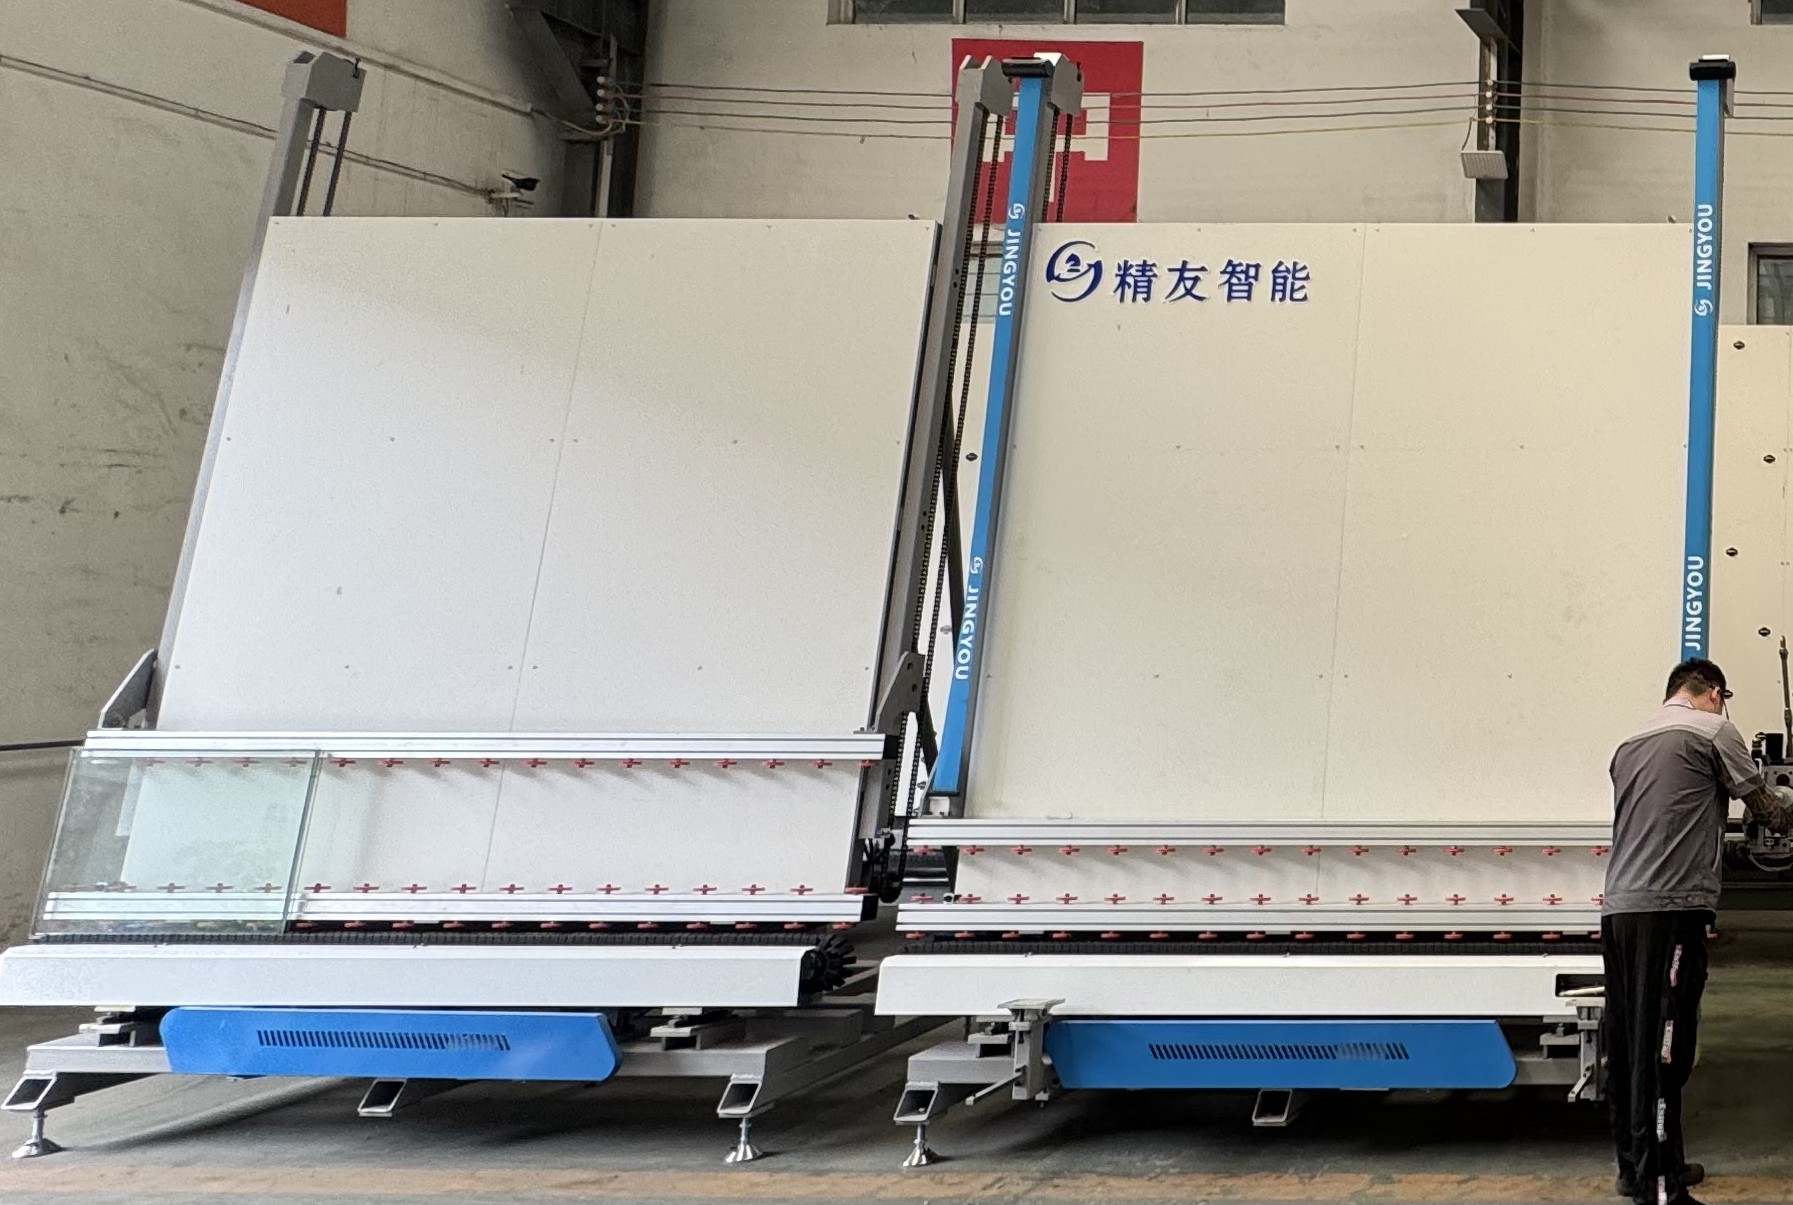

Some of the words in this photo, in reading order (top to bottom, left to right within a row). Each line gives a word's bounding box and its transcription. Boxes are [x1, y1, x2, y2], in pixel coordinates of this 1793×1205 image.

[998, 228, 1022, 317] JINGYOU
[1112, 258, 1312, 304] 精友智能
[1696, 203, 1714, 290] JINGYOU
[955, 584, 979, 680] JINGYOU
[1685, 555, 1704, 650] JINGYOU
